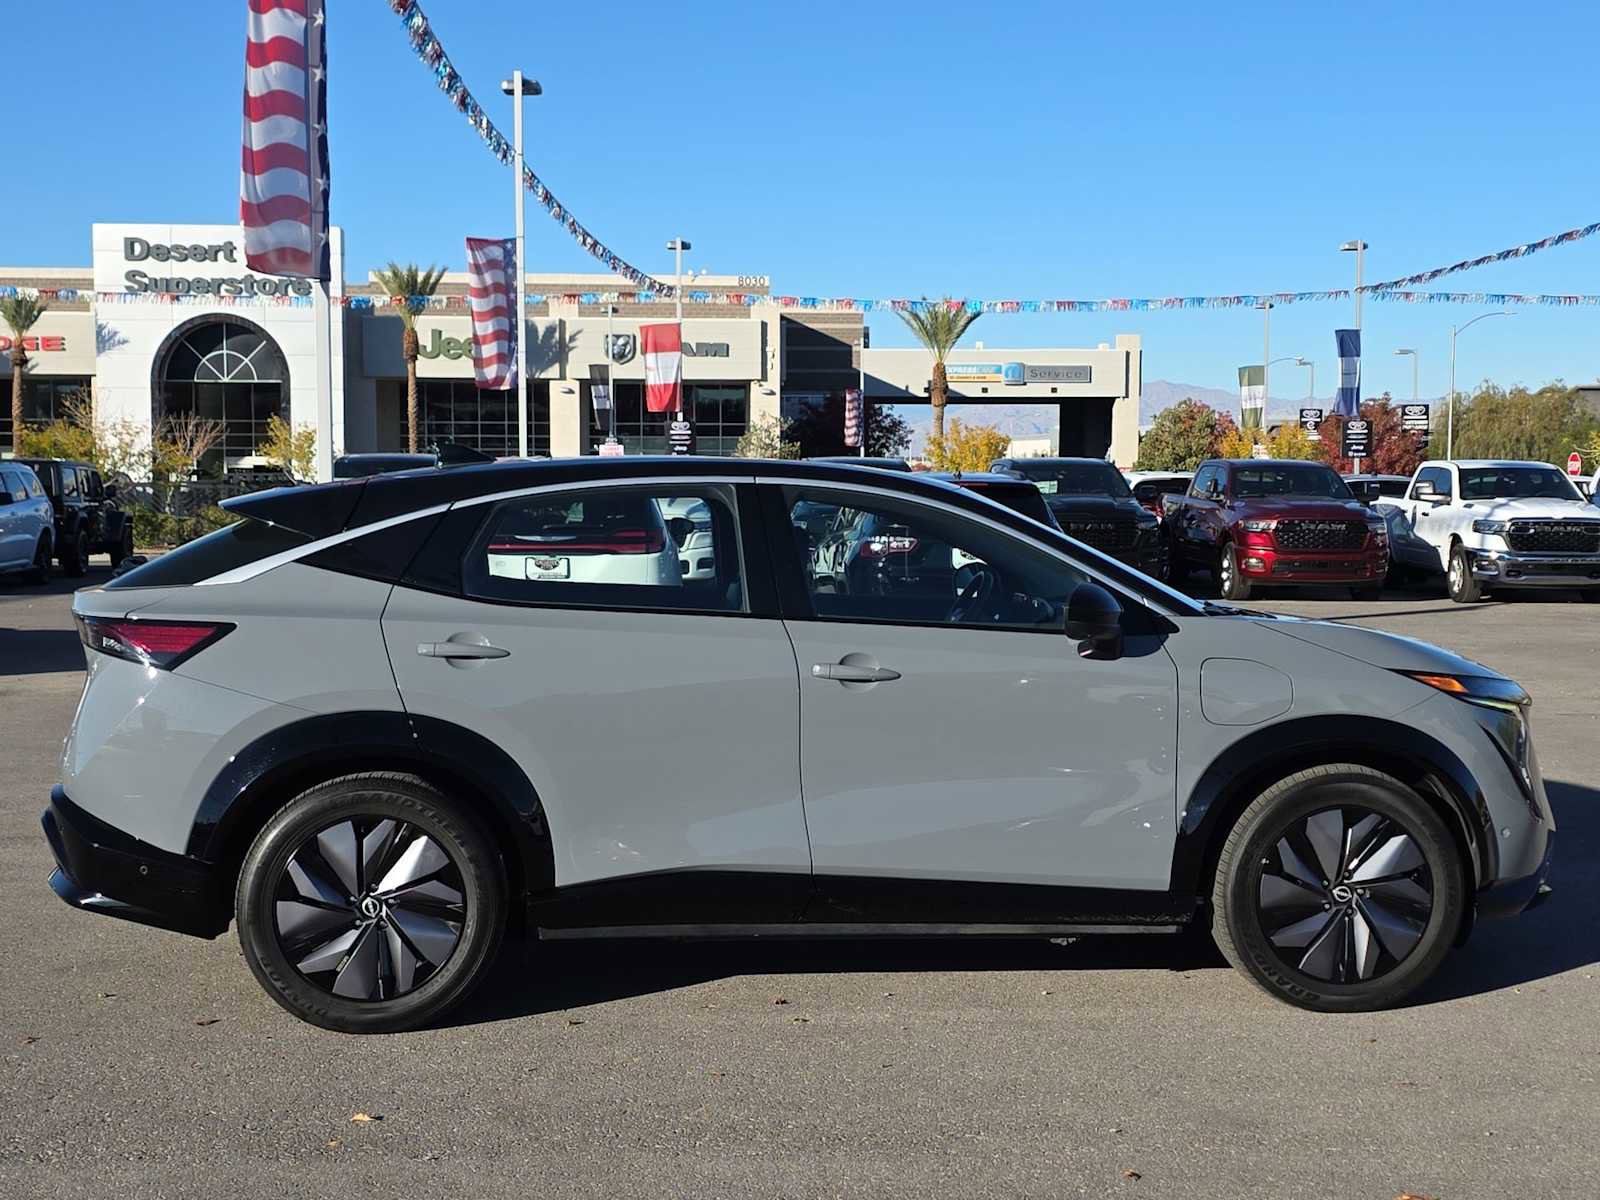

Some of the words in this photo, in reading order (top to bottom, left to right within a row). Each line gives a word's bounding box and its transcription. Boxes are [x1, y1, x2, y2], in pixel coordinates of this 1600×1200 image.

[123, 237, 237, 263] Desert
[124, 270, 313, 297] Superstore
[738, 275, 766, 288] 8030
[1030, 369, 1083, 379] Service
